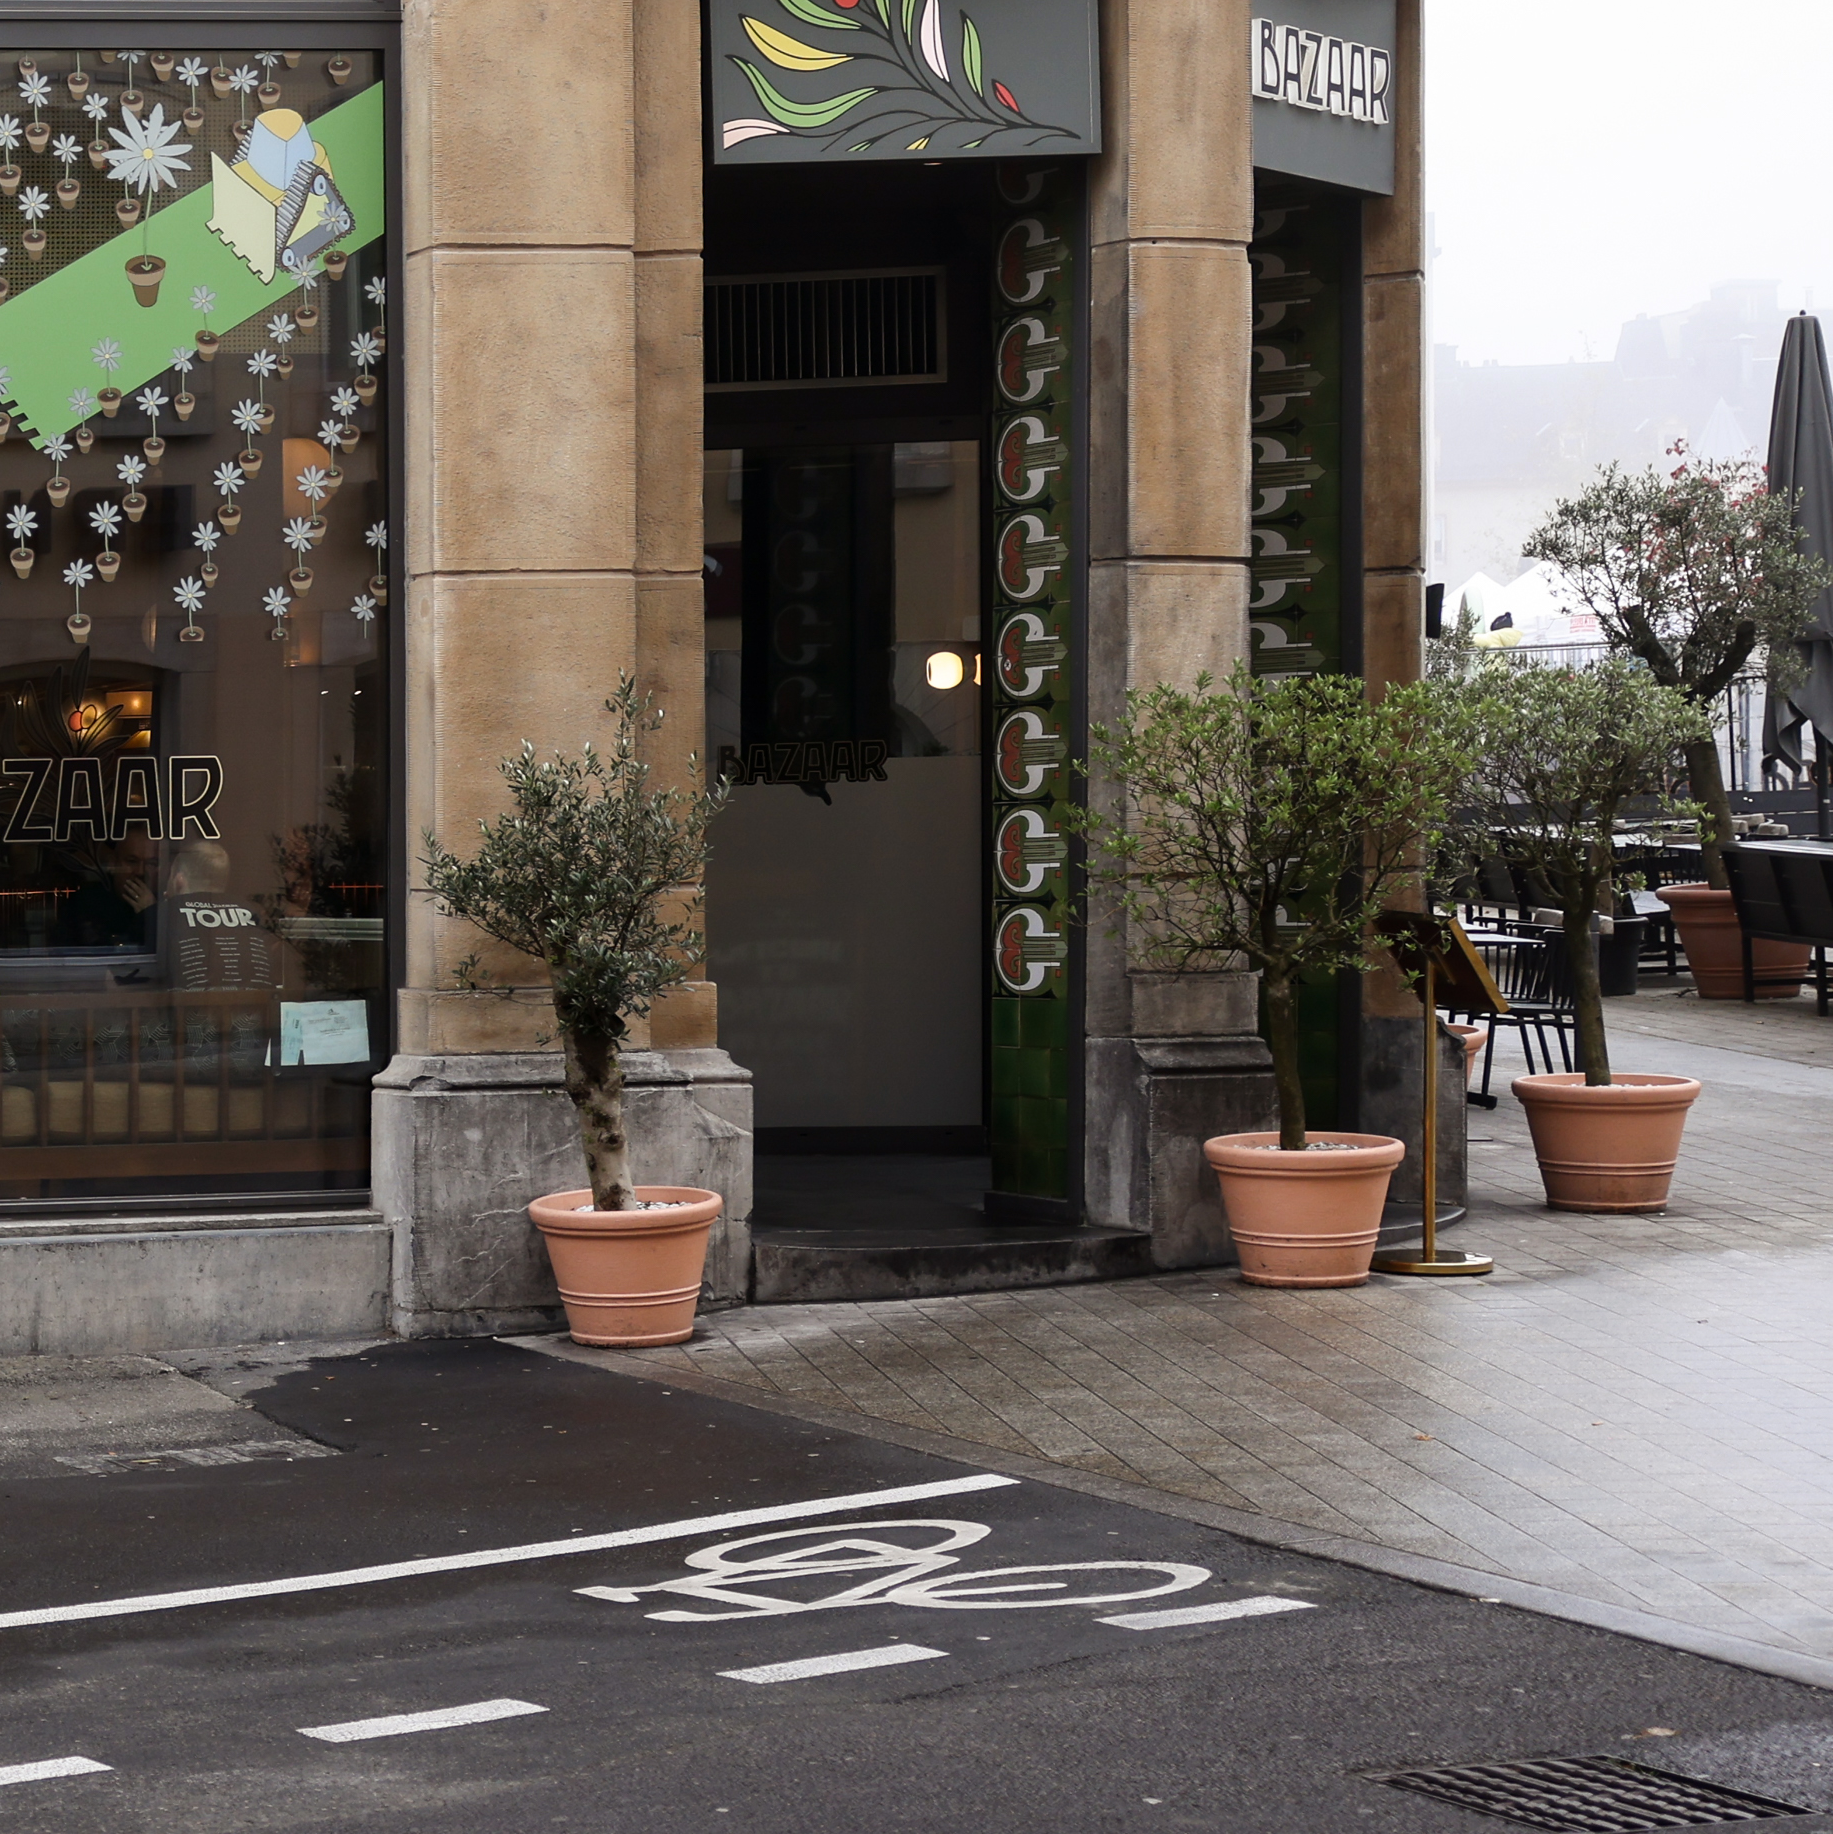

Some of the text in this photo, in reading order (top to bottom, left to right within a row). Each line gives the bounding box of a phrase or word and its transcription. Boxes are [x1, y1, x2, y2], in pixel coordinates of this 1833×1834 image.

[1251, 17, 1392, 126] BAZAAR
[716, 739, 889, 785] BAZAAR
[179, 908, 257, 928] TOUR
